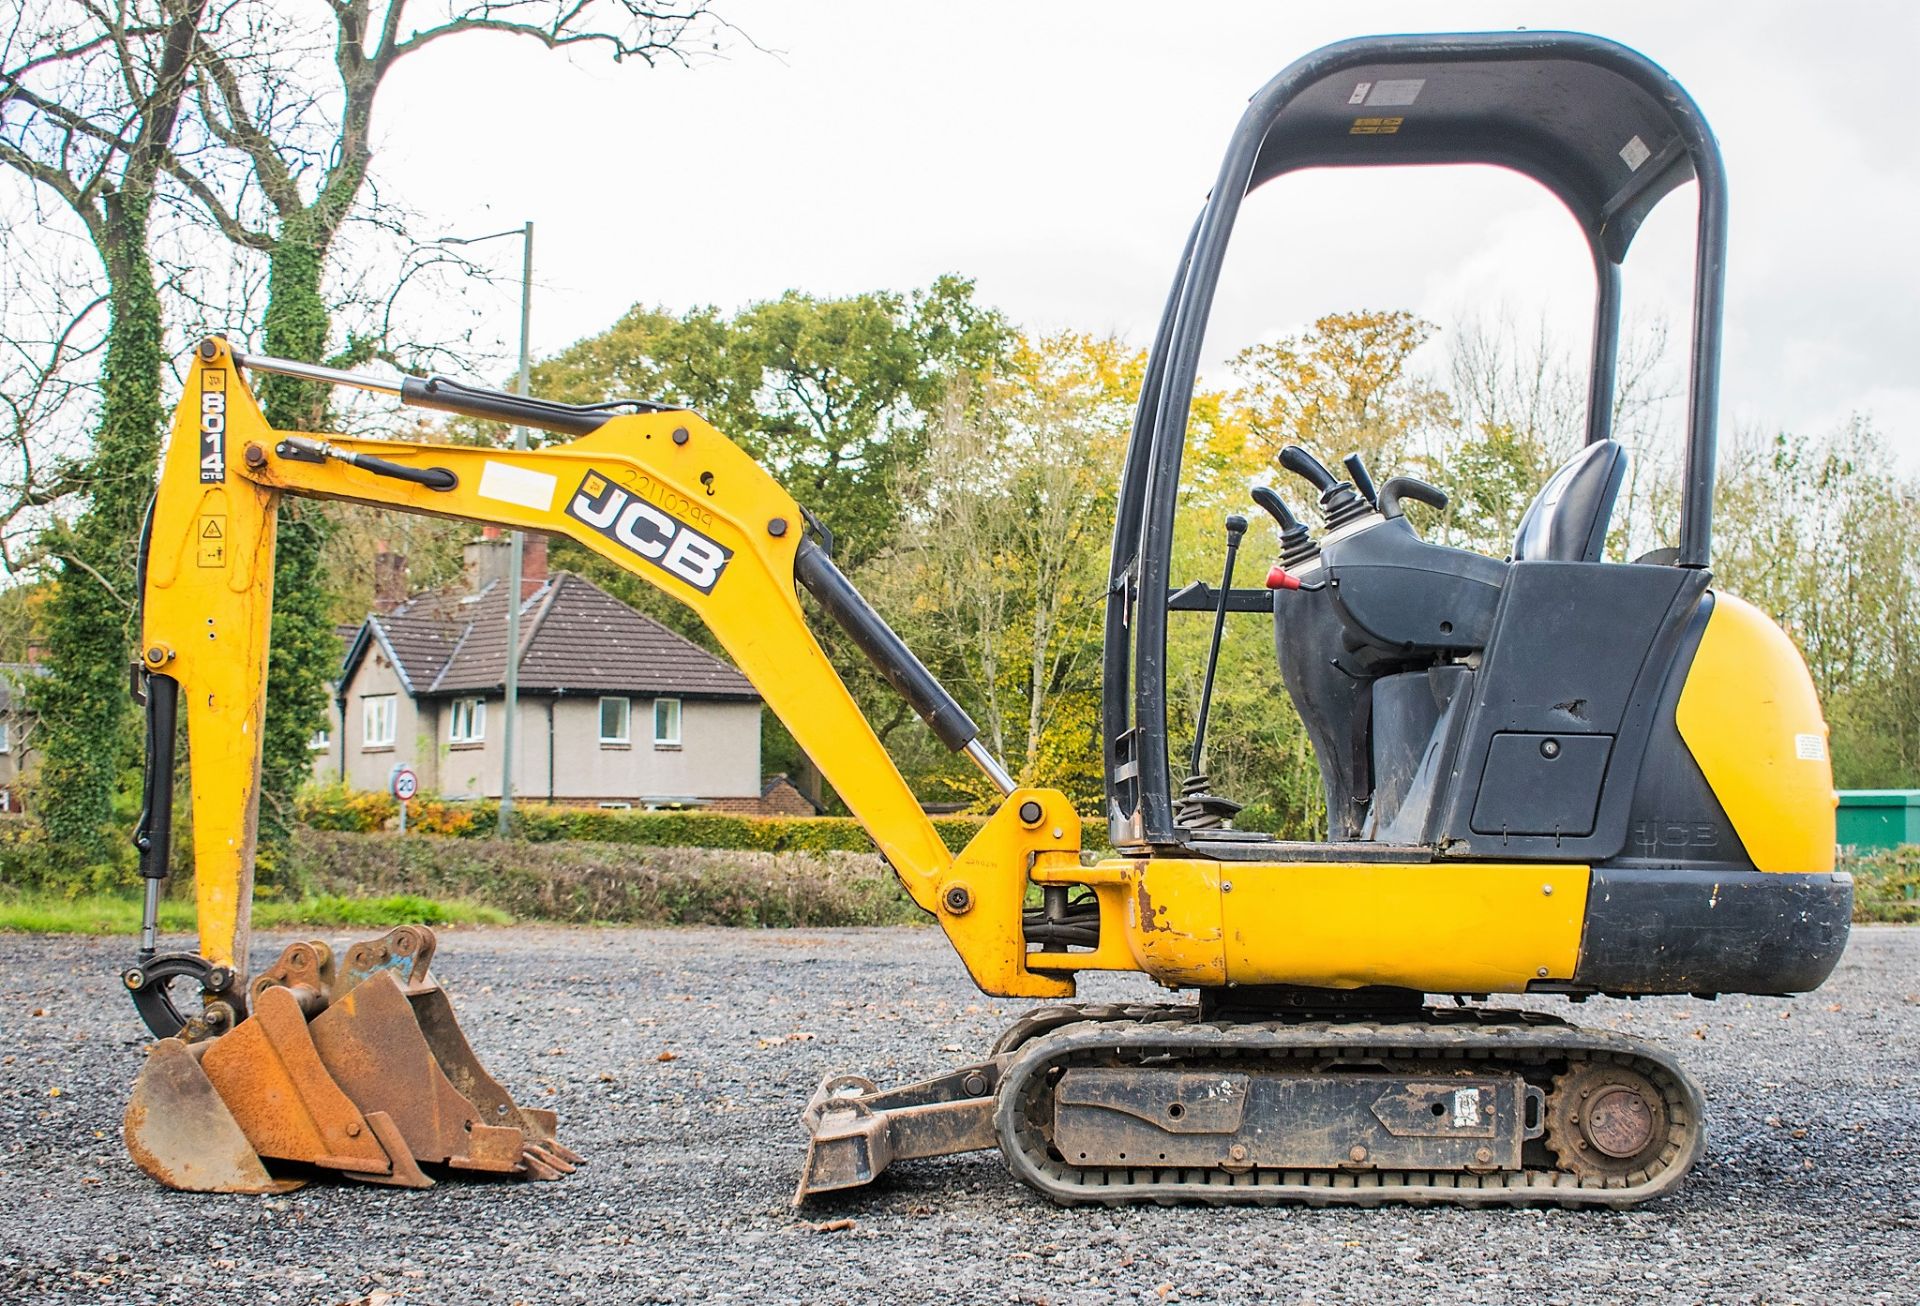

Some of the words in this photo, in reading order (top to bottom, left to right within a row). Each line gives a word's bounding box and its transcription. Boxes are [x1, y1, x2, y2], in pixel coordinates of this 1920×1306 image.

[201, 393, 225, 472] 8014
[621, 469, 713, 529] 22110299
[572, 487, 725, 589] JCB
[399, 779, 414, 791] 20
[1635, 821, 1720, 847] JCB
